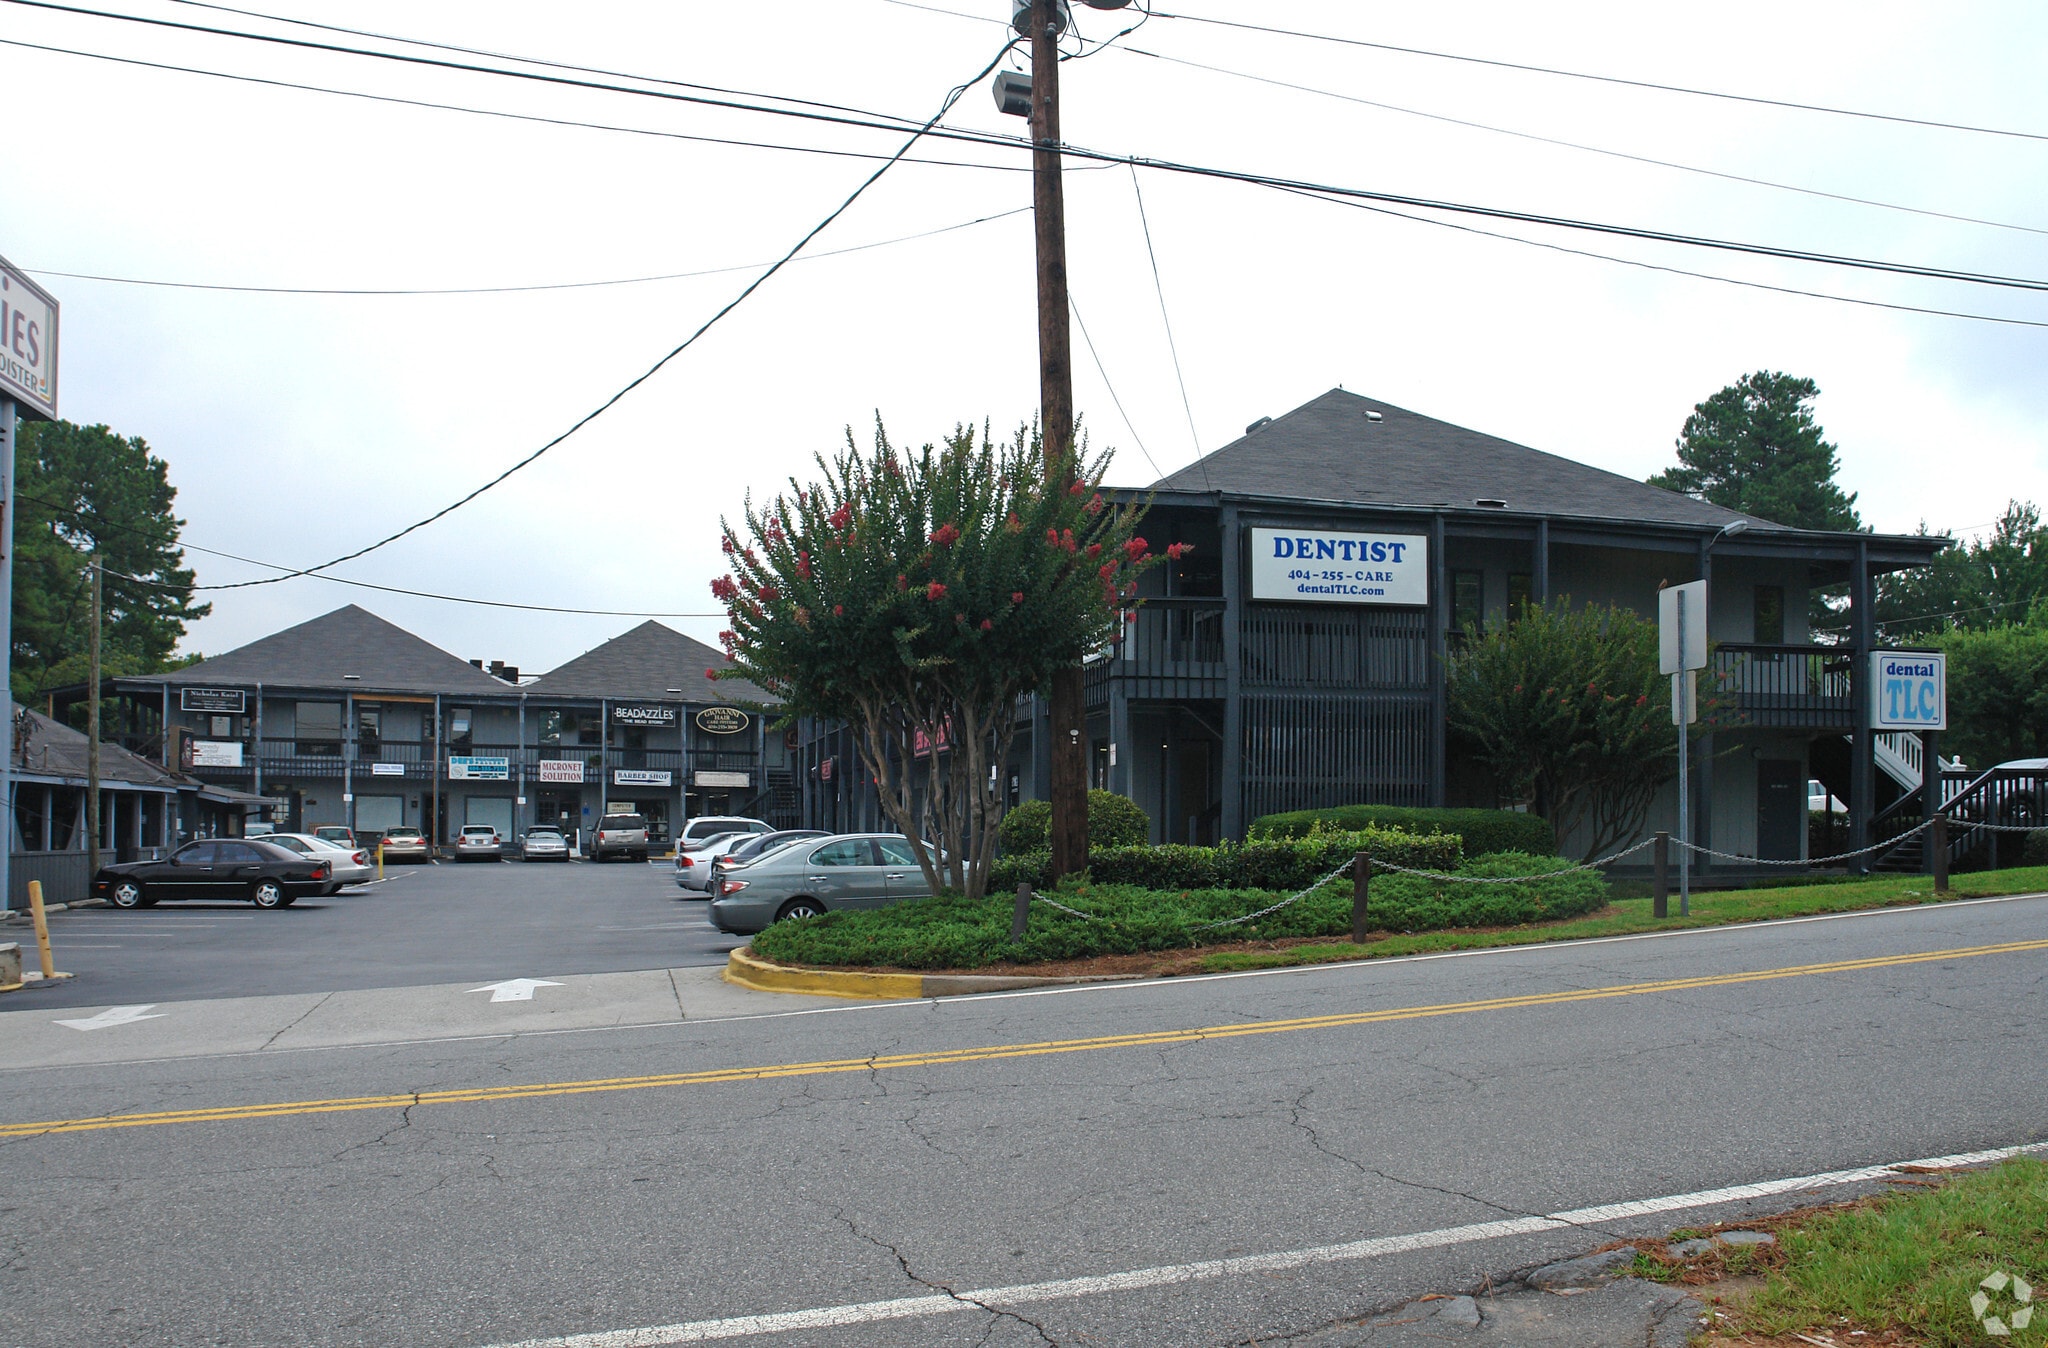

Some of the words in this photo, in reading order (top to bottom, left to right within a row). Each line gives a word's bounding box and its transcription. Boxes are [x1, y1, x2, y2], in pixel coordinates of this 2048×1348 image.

[1273, 537, 1406, 563] DENTIST
[1297, 583, 1385, 596] dentalTLC.com
[1886, 662, 1934, 677] dental
[1886, 679, 1935, 720] TLC
[703, 709, 740, 718] GIOVANNI
[542, 762, 582, 771] MICRONET
[542, 772, 582, 781] SOLUTION
[617, 771, 647, 779] BARBER
[648, 772, 670, 780] SHOP
